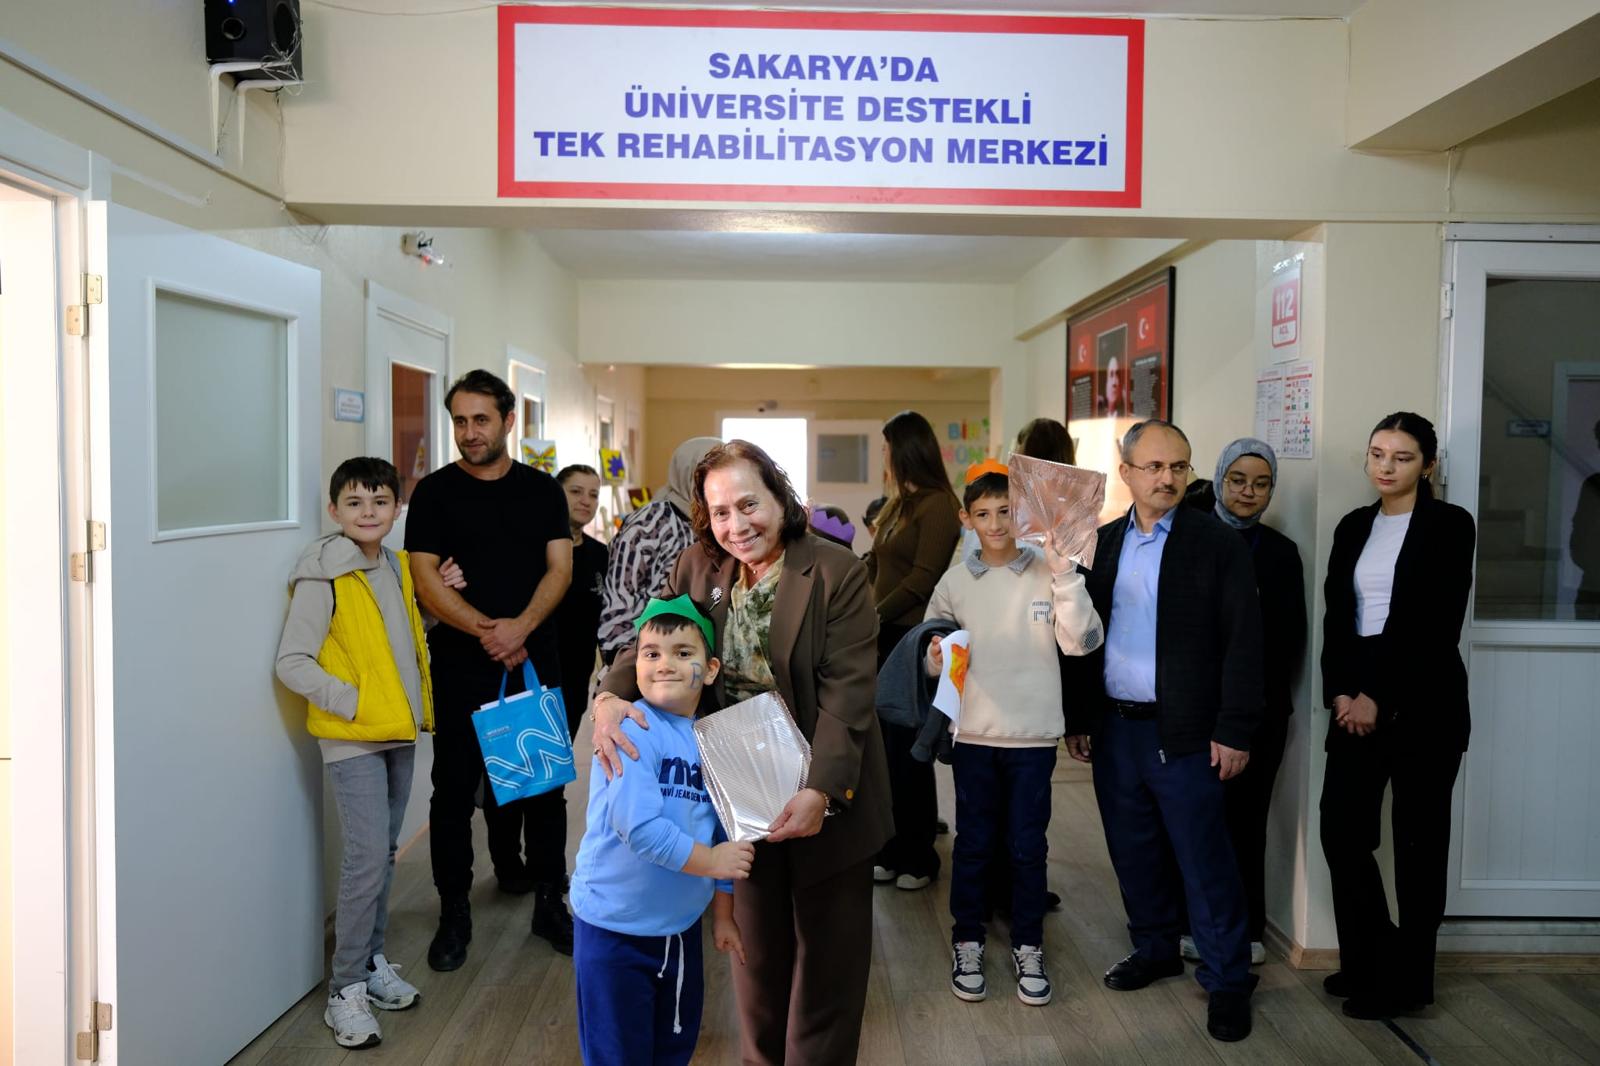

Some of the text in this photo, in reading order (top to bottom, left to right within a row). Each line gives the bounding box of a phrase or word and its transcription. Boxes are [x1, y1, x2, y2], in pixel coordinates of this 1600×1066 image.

[624, 84, 1031, 125] ÜNİVERSİTE DESTEKLİ
[533, 127, 1108, 167] TEK REHABİLİTASYON MERKEZİ
[1275, 287, 1295, 321] 112
